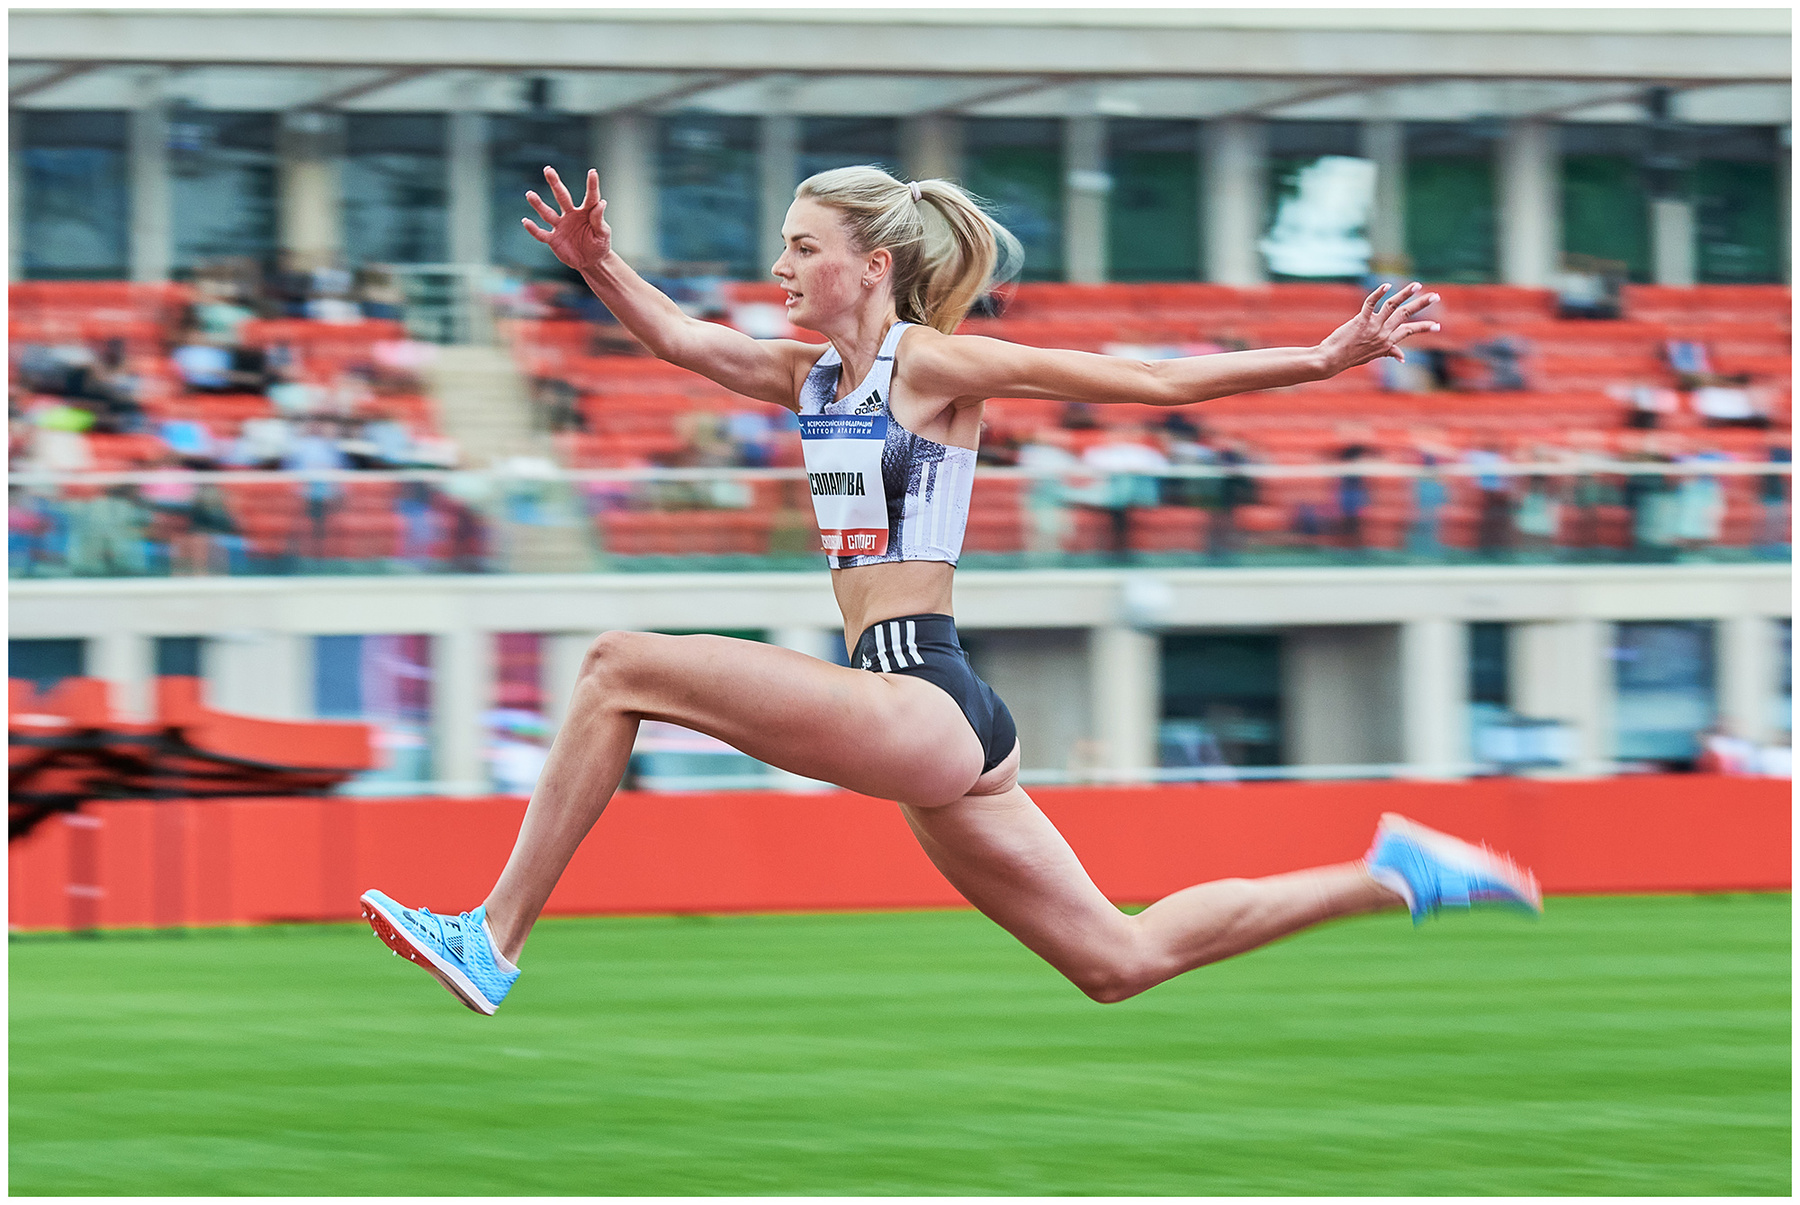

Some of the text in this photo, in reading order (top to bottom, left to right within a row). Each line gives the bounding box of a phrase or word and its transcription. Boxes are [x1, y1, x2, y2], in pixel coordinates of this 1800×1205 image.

[855, 402, 884, 415] adidas
[807, 472, 865, 496] СОЛАПОВА
[847, 534, 877, 550] СПОРТ
